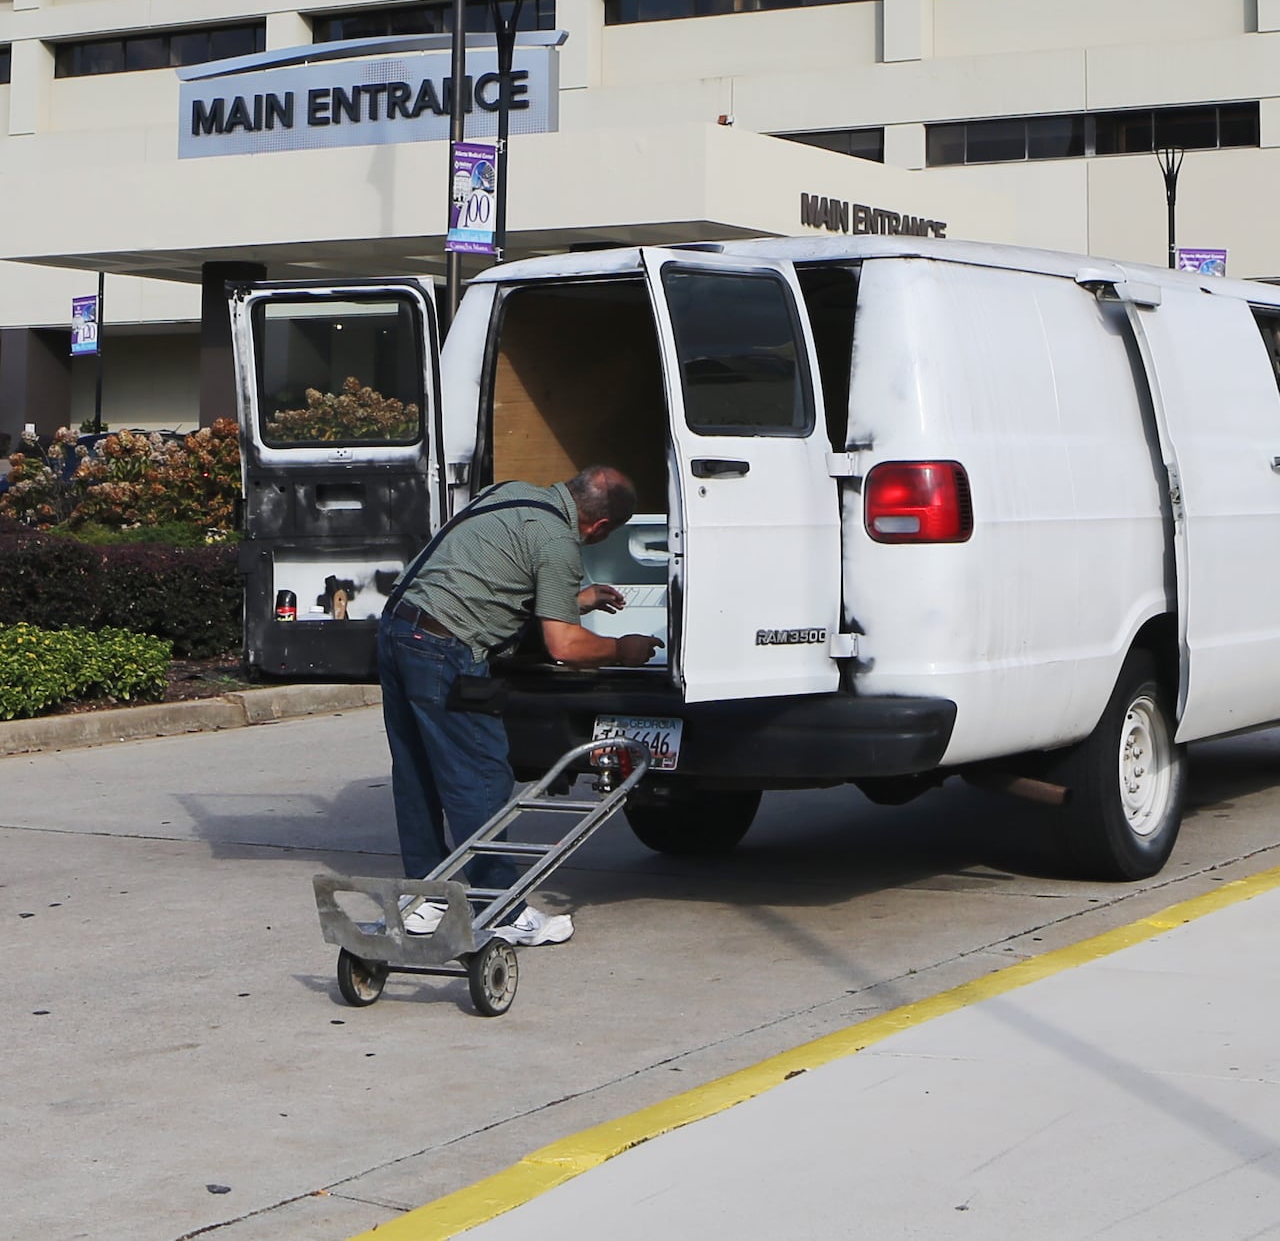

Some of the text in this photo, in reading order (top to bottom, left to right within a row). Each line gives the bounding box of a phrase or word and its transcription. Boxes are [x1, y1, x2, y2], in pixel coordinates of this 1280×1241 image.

[192, 69, 530, 137] MAIN ENTRANCE
[800, 192, 947, 238] MAIN ENTRANCE
[756, 629, 788, 645] RAM
[629, 719, 677, 730] GEORGIA
